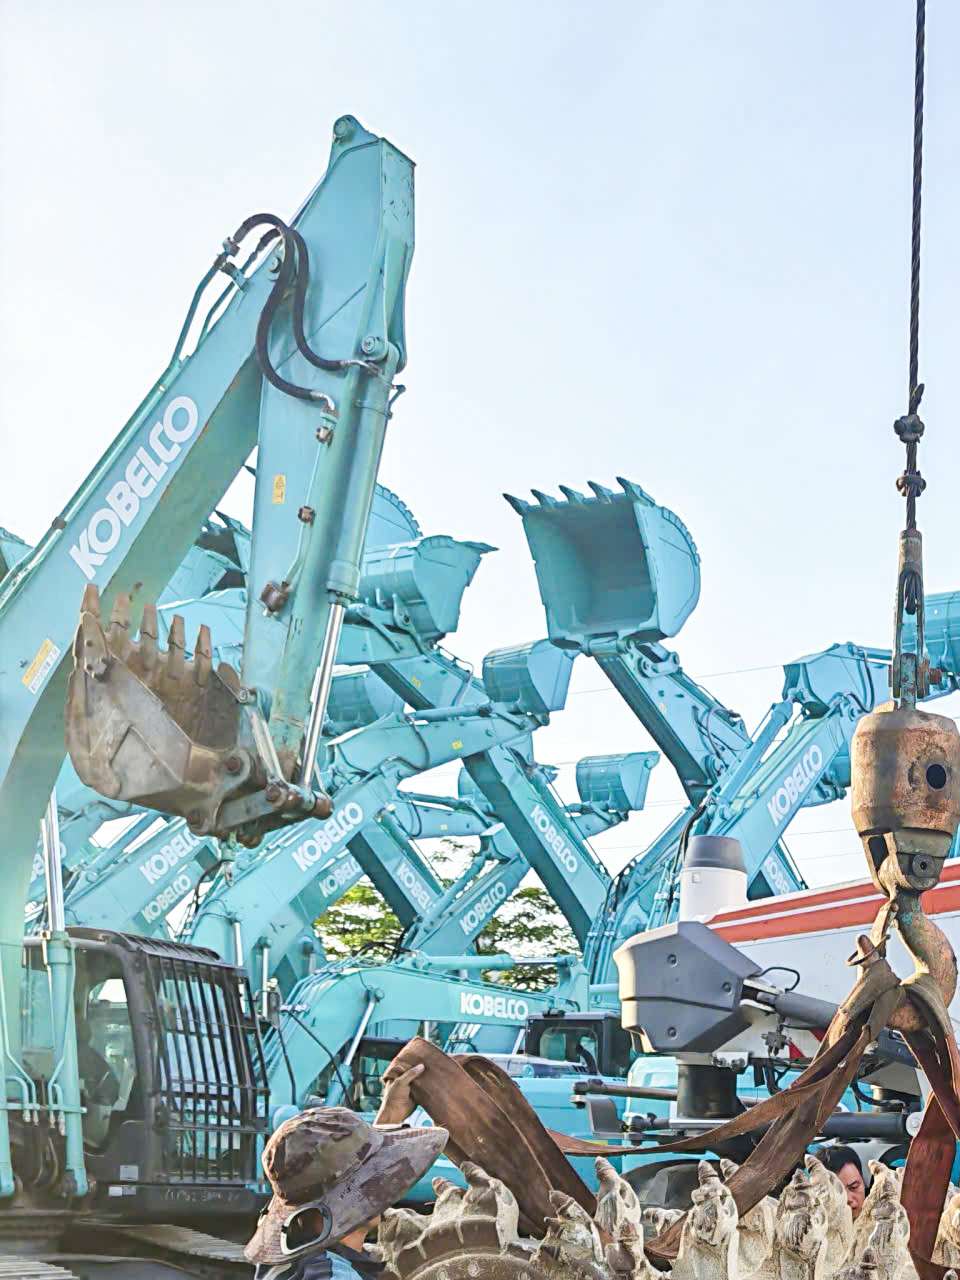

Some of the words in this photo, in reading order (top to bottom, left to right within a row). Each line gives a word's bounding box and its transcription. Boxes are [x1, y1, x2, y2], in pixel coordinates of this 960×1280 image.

[69, 396, 198, 581] KOBELCO
[767, 744, 823, 827] KOBELCO
[291, 802, 363, 872] KOBELCO
[530, 804, 578, 873] KOBELCO
[141, 874, 191, 924] KOBELCO
[459, 882, 507, 935] KOBELCO
[461, 992, 529, 1020] KOBELCO
